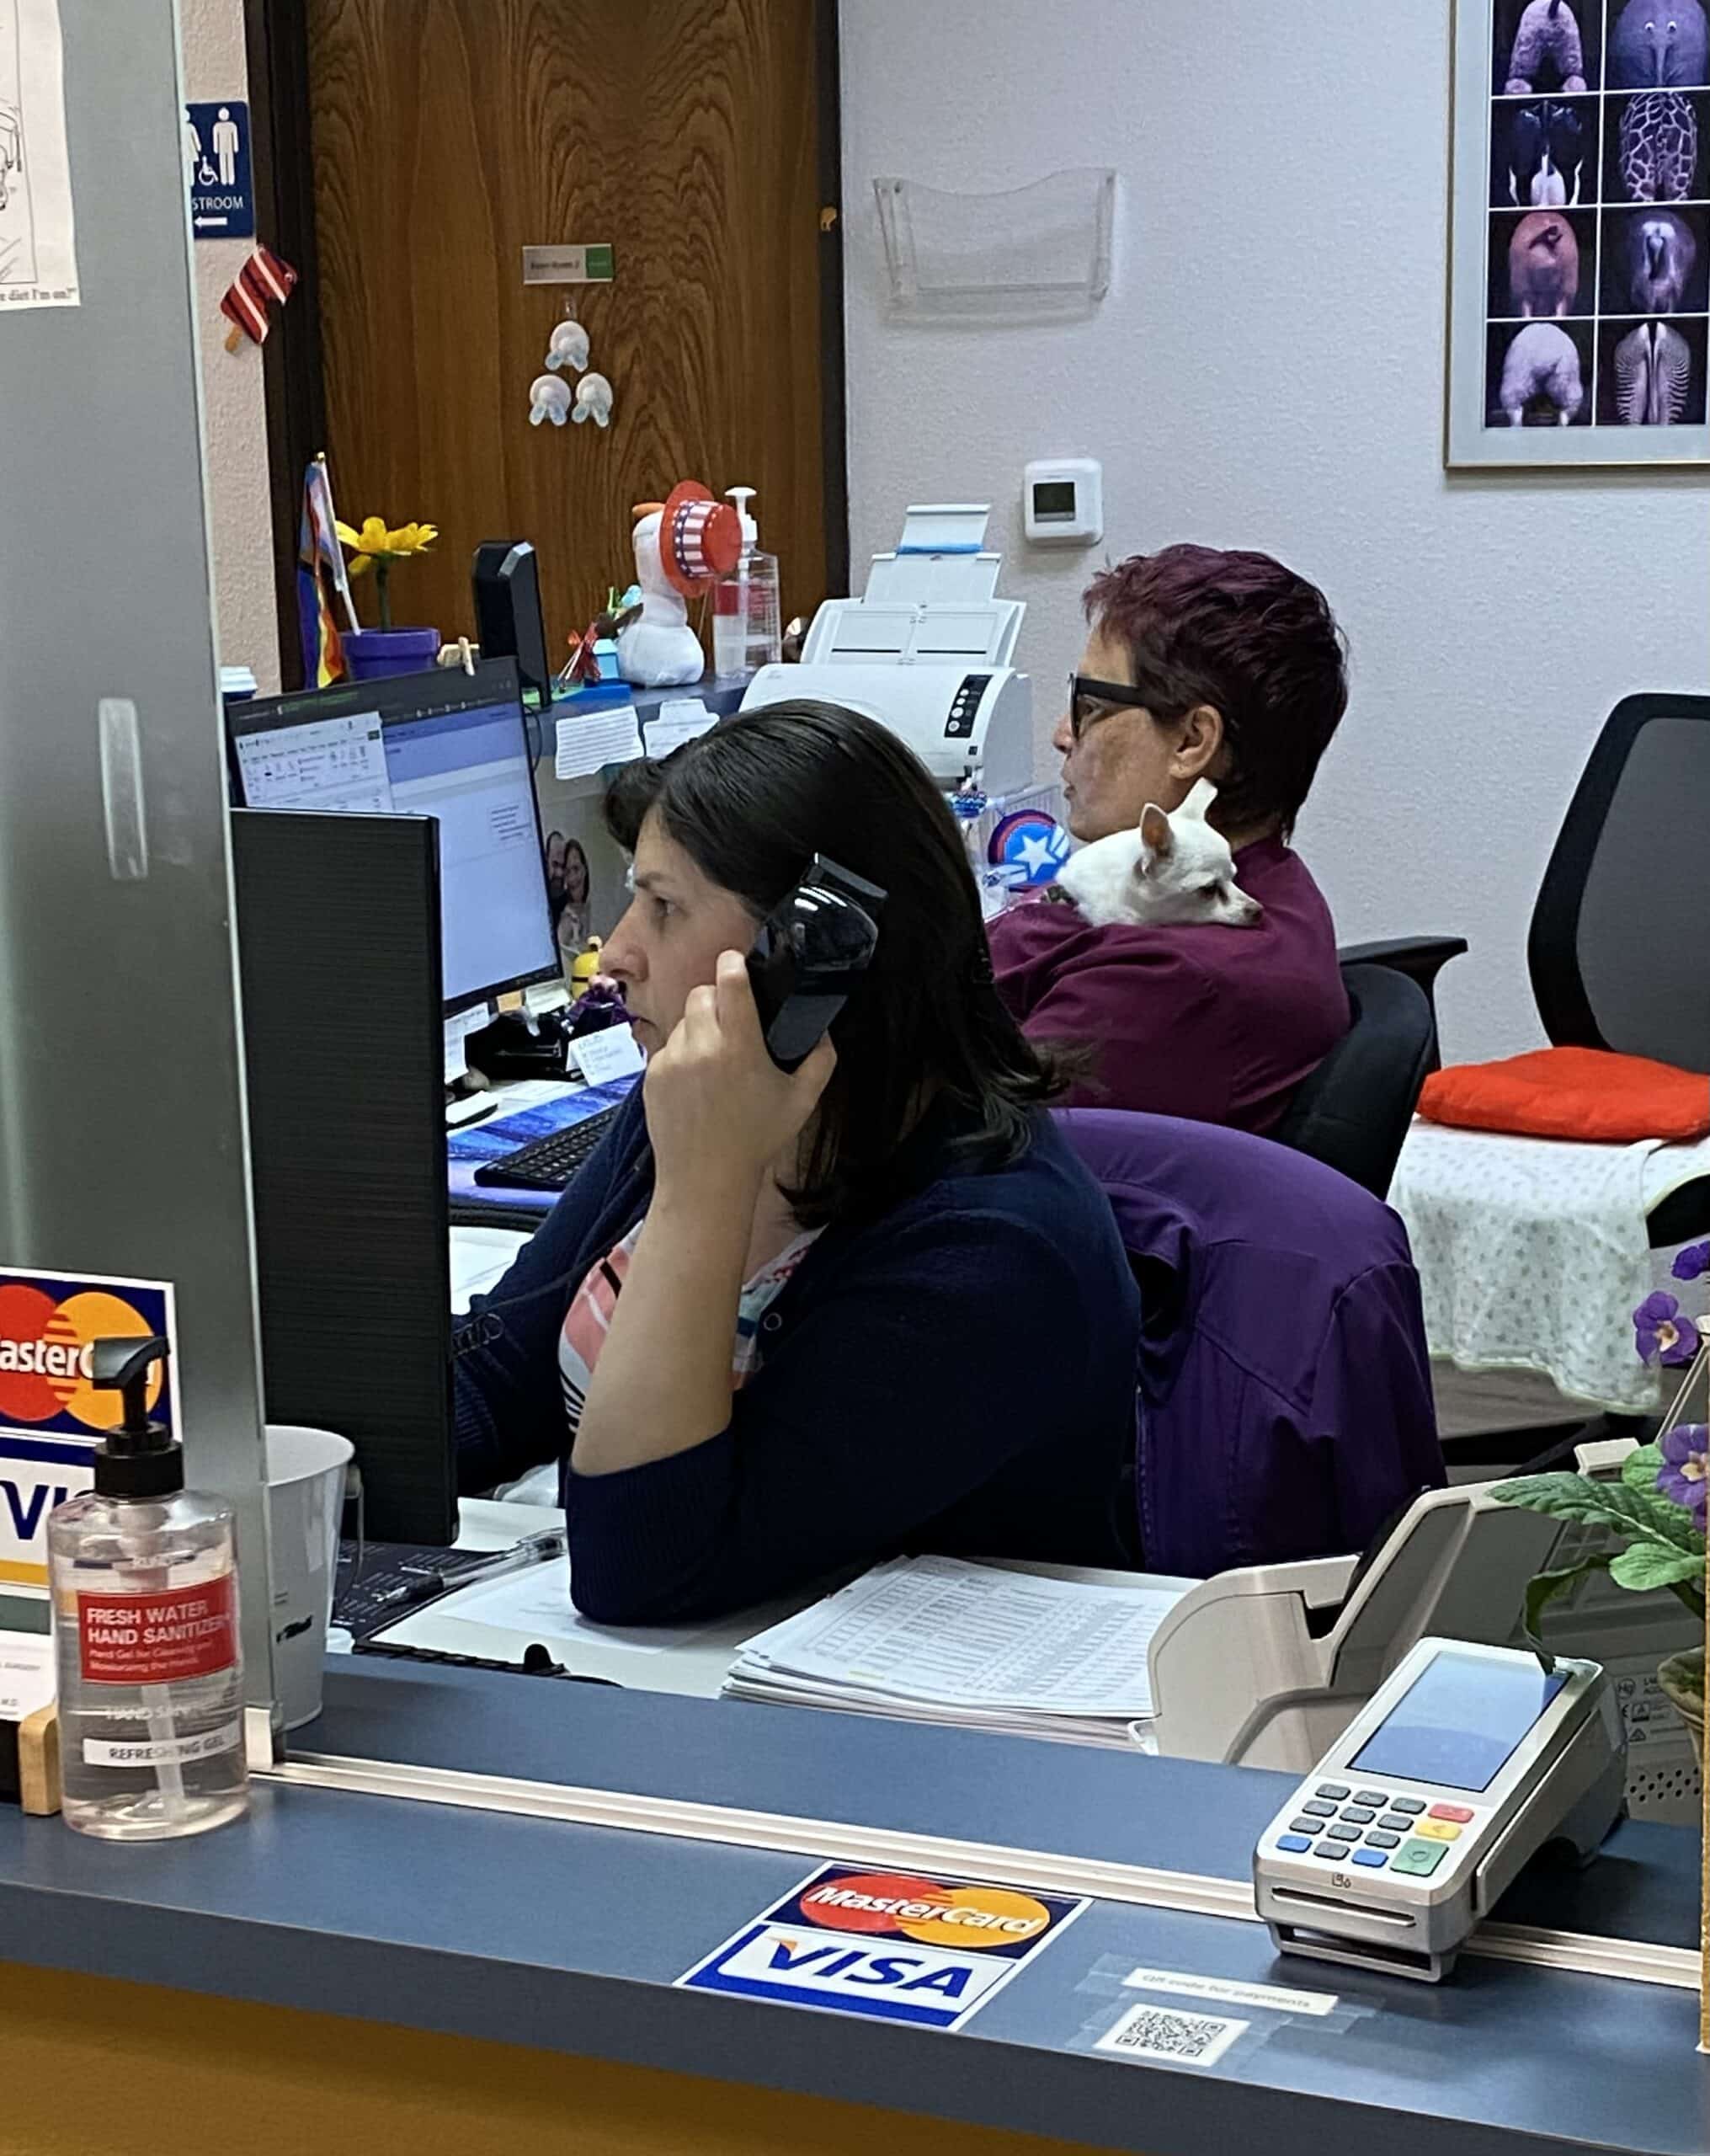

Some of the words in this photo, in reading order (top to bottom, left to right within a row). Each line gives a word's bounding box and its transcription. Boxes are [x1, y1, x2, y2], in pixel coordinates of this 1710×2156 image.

[192, 196, 243, 211] STROOM
[87, 1608, 142, 1626] FRESH
[146, 1600, 209, 1625] WATER
[88, 1628, 138, 1644] HAND
[806, 1885, 1041, 1935] MasterCard
[767, 1937, 973, 1999] VISA
